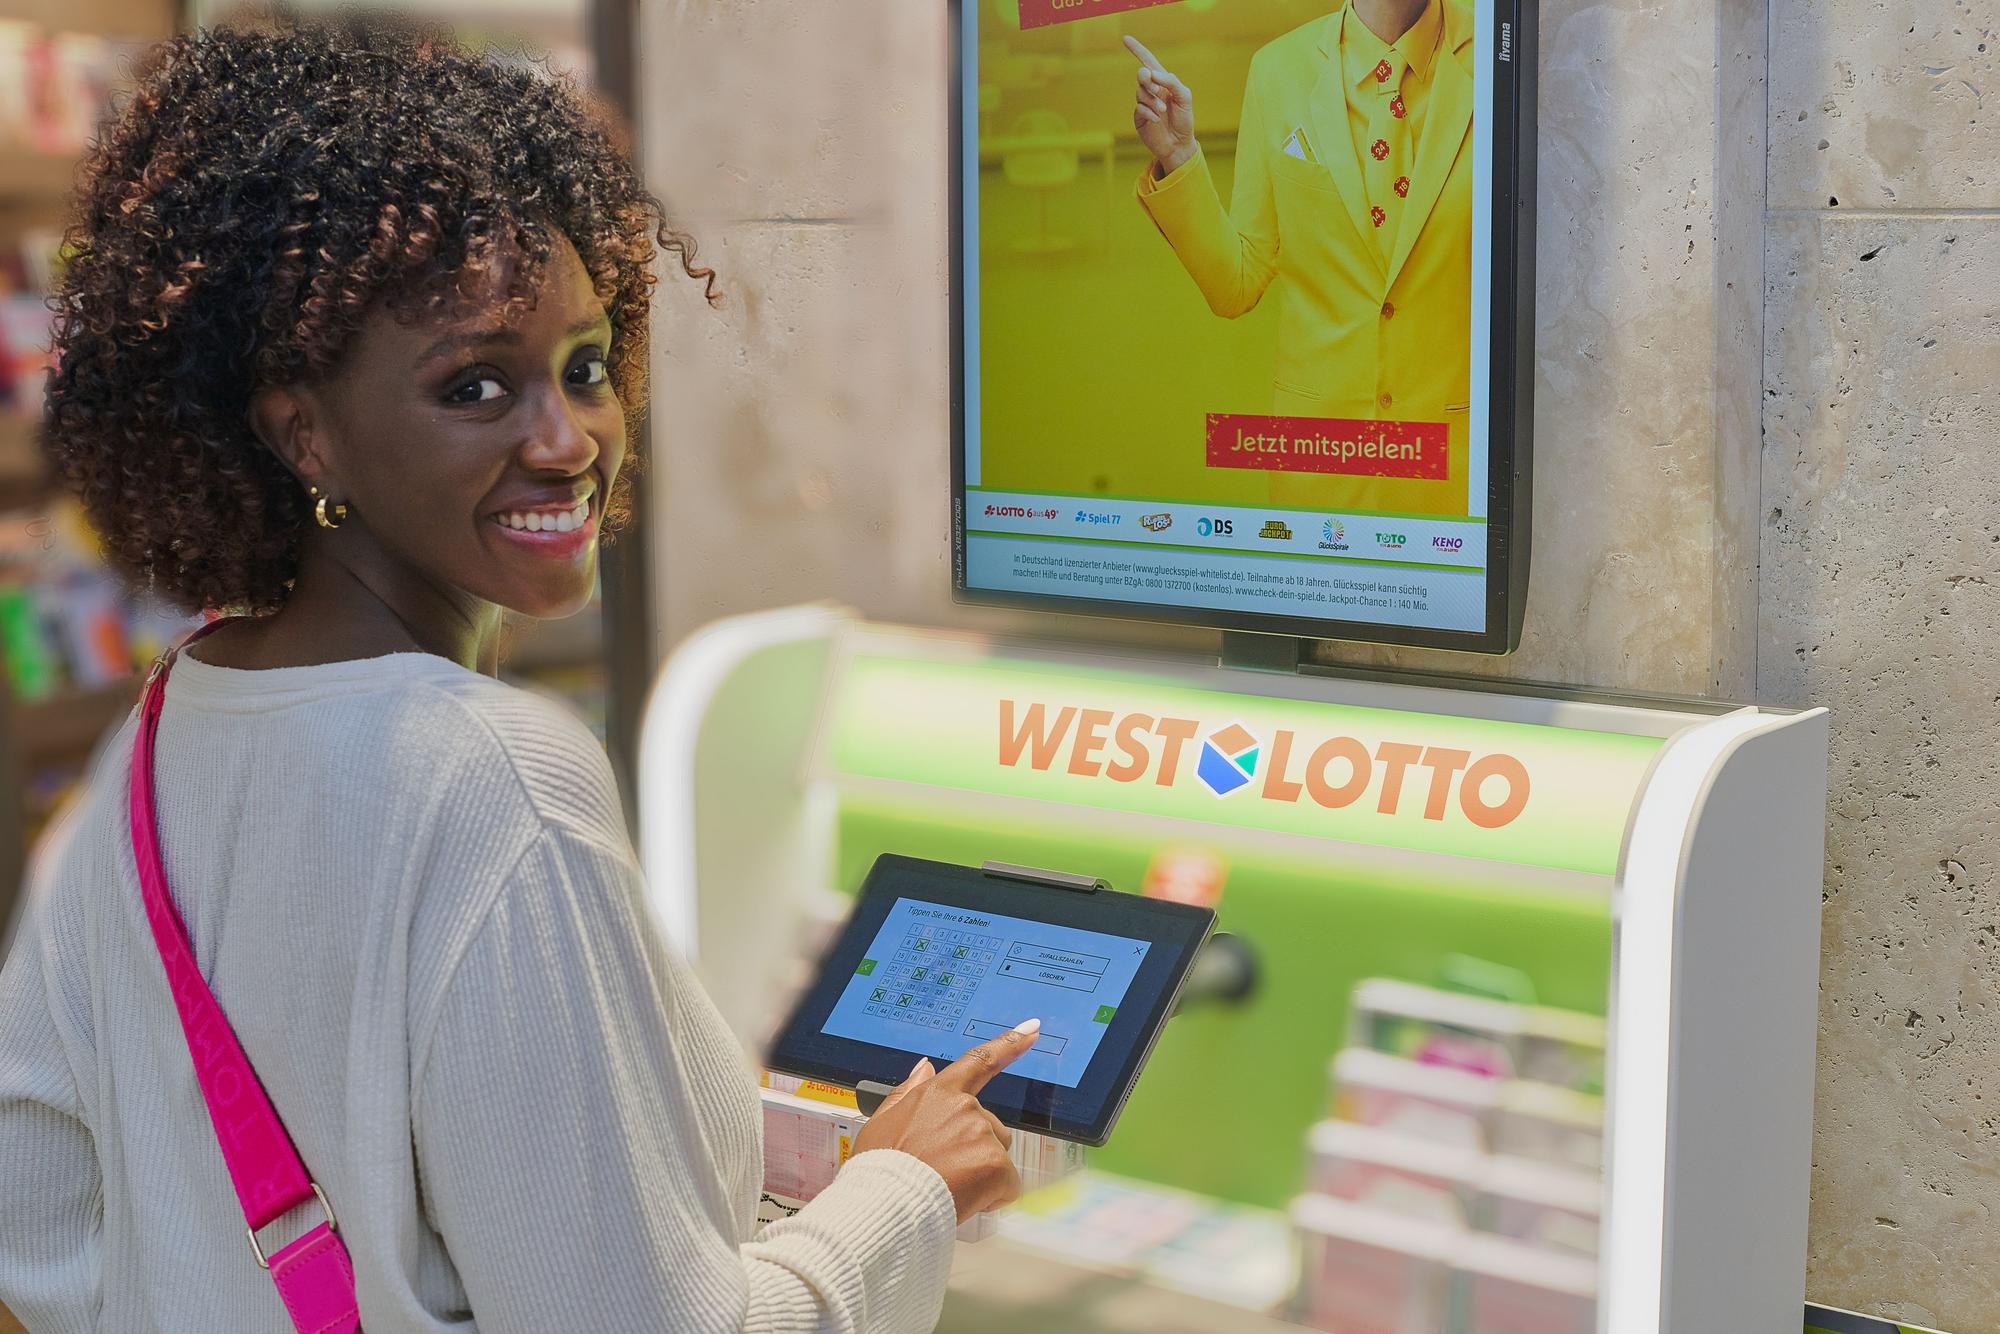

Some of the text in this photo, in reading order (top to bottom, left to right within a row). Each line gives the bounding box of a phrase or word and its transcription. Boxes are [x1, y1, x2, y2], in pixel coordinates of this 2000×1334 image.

[1498, 22, 1510, 62] iiyama
[1376, 65, 1386, 77] 12
[1376, 144, 1386, 156] 24
[1232, 428, 1422, 464] Jetzt mitspielen!
[996, 506, 1025, 517] LOTTO
[1088, 514, 1121, 524] Spiel 77
[1214, 519, 1233, 534] DS
[1376, 533, 1406, 544] TOTO
[1432, 536, 1463, 548] KENO
[1014, 554, 1427, 598] In Deutschland lizenzierter Anbieter (www.gluecksspiel-whitelist.de). Teilnahme ab 18 Jahren. Glücksspiel kann süchtig
[1013, 568, 1041, 578] machen!
[1042, 570, 1057, 580] Hilfe
[1059, 572, 1072, 580] und
[1073, 572, 1103, 585] Beratung
[1105, 576, 1123, 585] unter
[1124, 577, 1143, 588] BZgA:
[1146, 578, 1162, 588] 0800
[1165, 580, 1191, 590] 1372700
[1193, 582, 1233, 596] (kostenlos).
[1235, 587, 1327, 602] www.check-dein-spiel.de.
[1329, 593, 1387, 607] Jackpot-Chance
[1399, 599, 1411, 609] 140
[1413, 600, 1429, 611] Mio.
[998, 698, 1531, 829] WEST LOTTO
[908, 906, 930, 917] Tippen
[931, 910, 942, 918] Sie
[943, 913, 957, 921] Ihre
[964, 917, 991, 927] Zahlen!
[1039, 952, 1084, 965] ZUFALLSZAHLEN
[1039, 971, 1065, 981] LÖSCHEN
[816, 1084, 838, 1094] LOTTO
